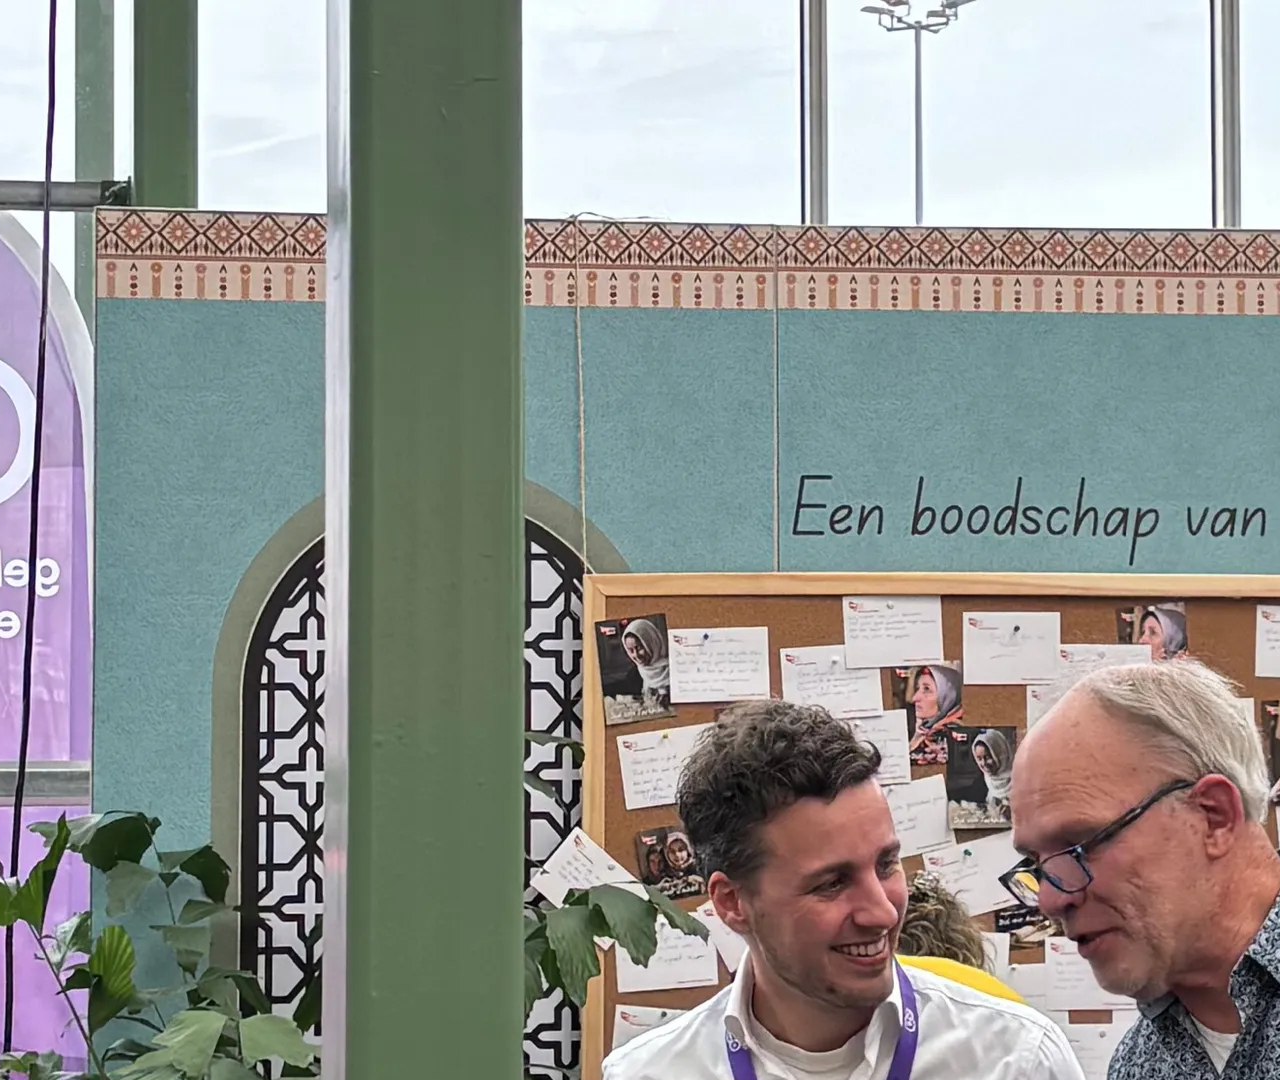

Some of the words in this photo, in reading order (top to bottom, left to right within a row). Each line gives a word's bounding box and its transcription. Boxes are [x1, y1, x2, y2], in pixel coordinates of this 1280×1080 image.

[792, 475, 883, 535] Een
[910, 476, 1160, 566] boodschap
[1187, 506, 1266, 537] van
